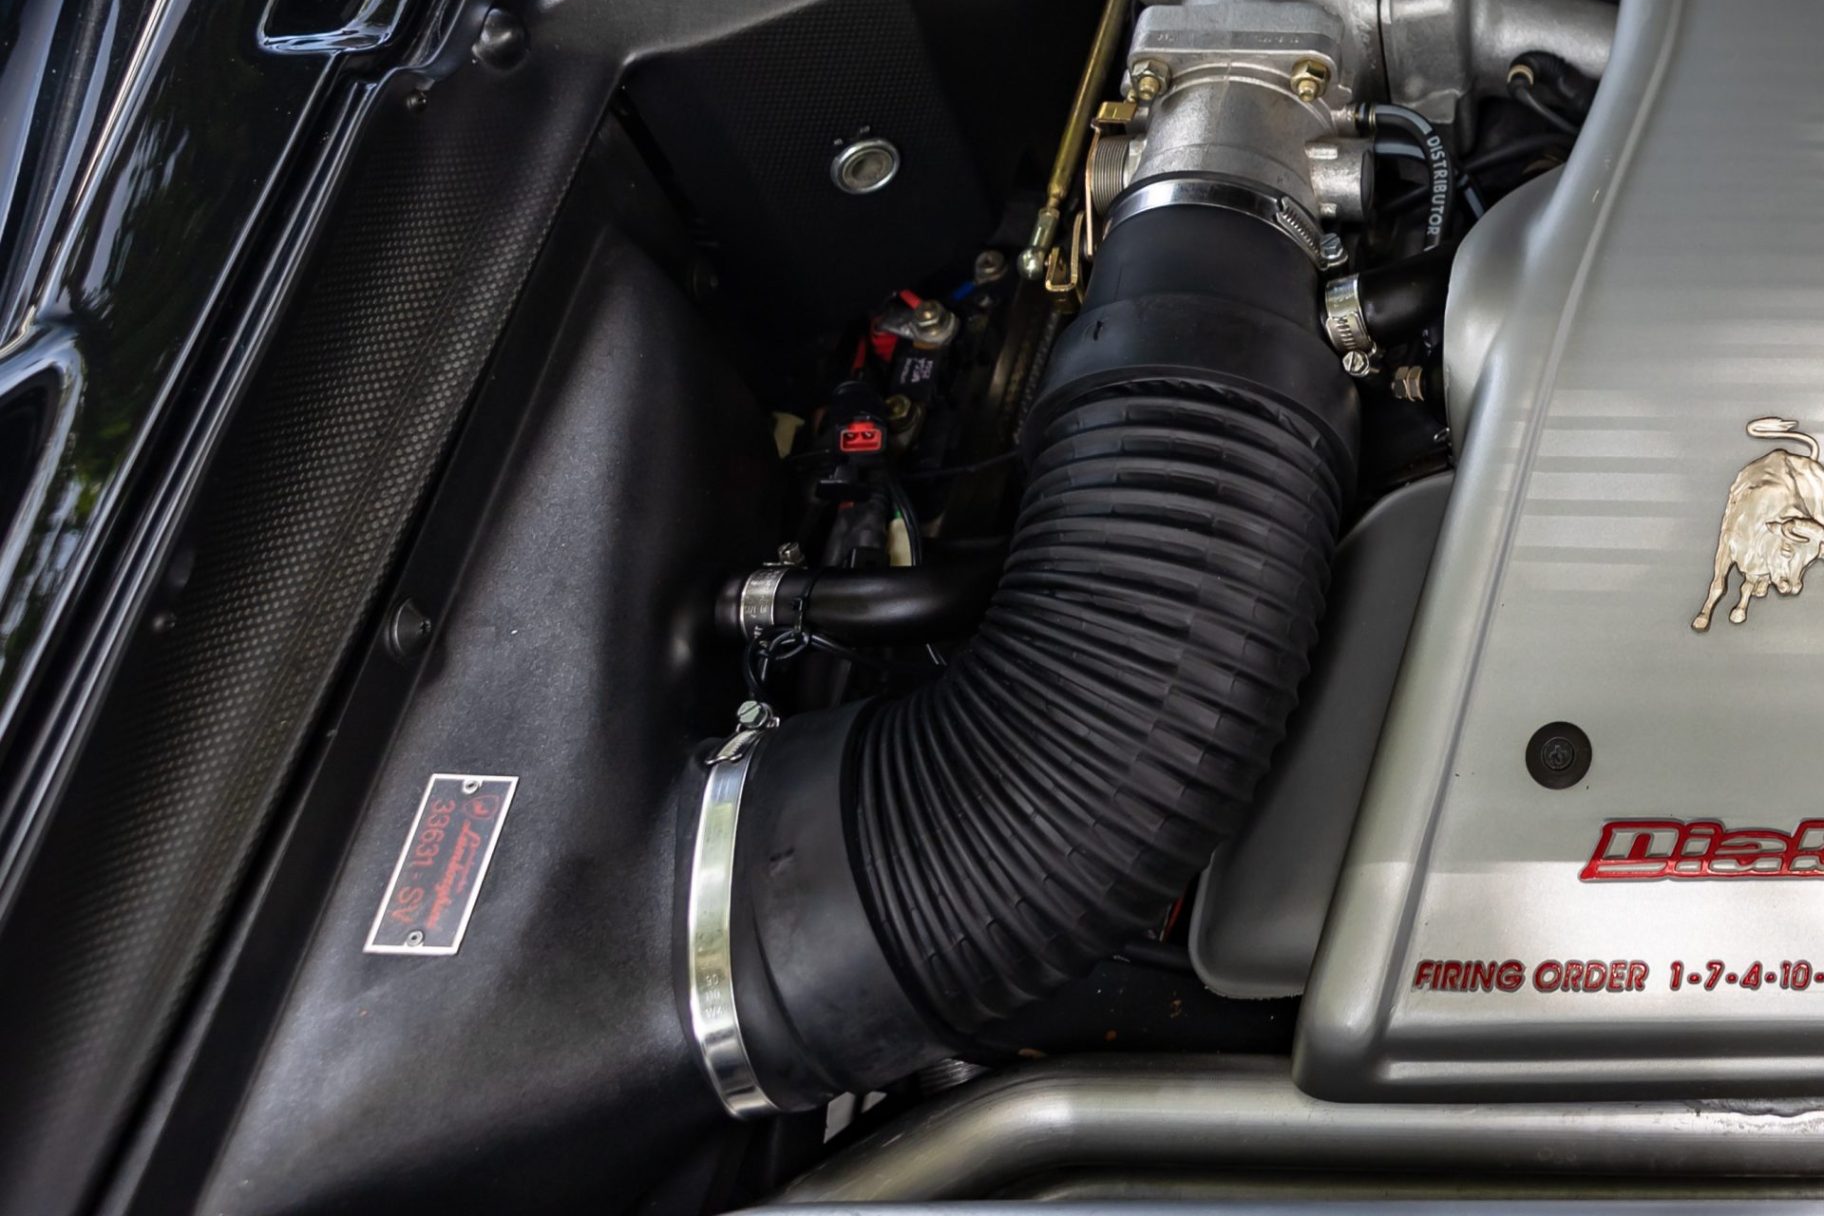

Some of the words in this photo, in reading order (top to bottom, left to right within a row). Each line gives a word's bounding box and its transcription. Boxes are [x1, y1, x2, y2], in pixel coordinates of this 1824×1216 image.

[1426, 135, 1449, 236] DISTRIBUTOR
[1411, 959, 1527, 993] FIRING
[1532, 959, 1650, 993] ORDER
